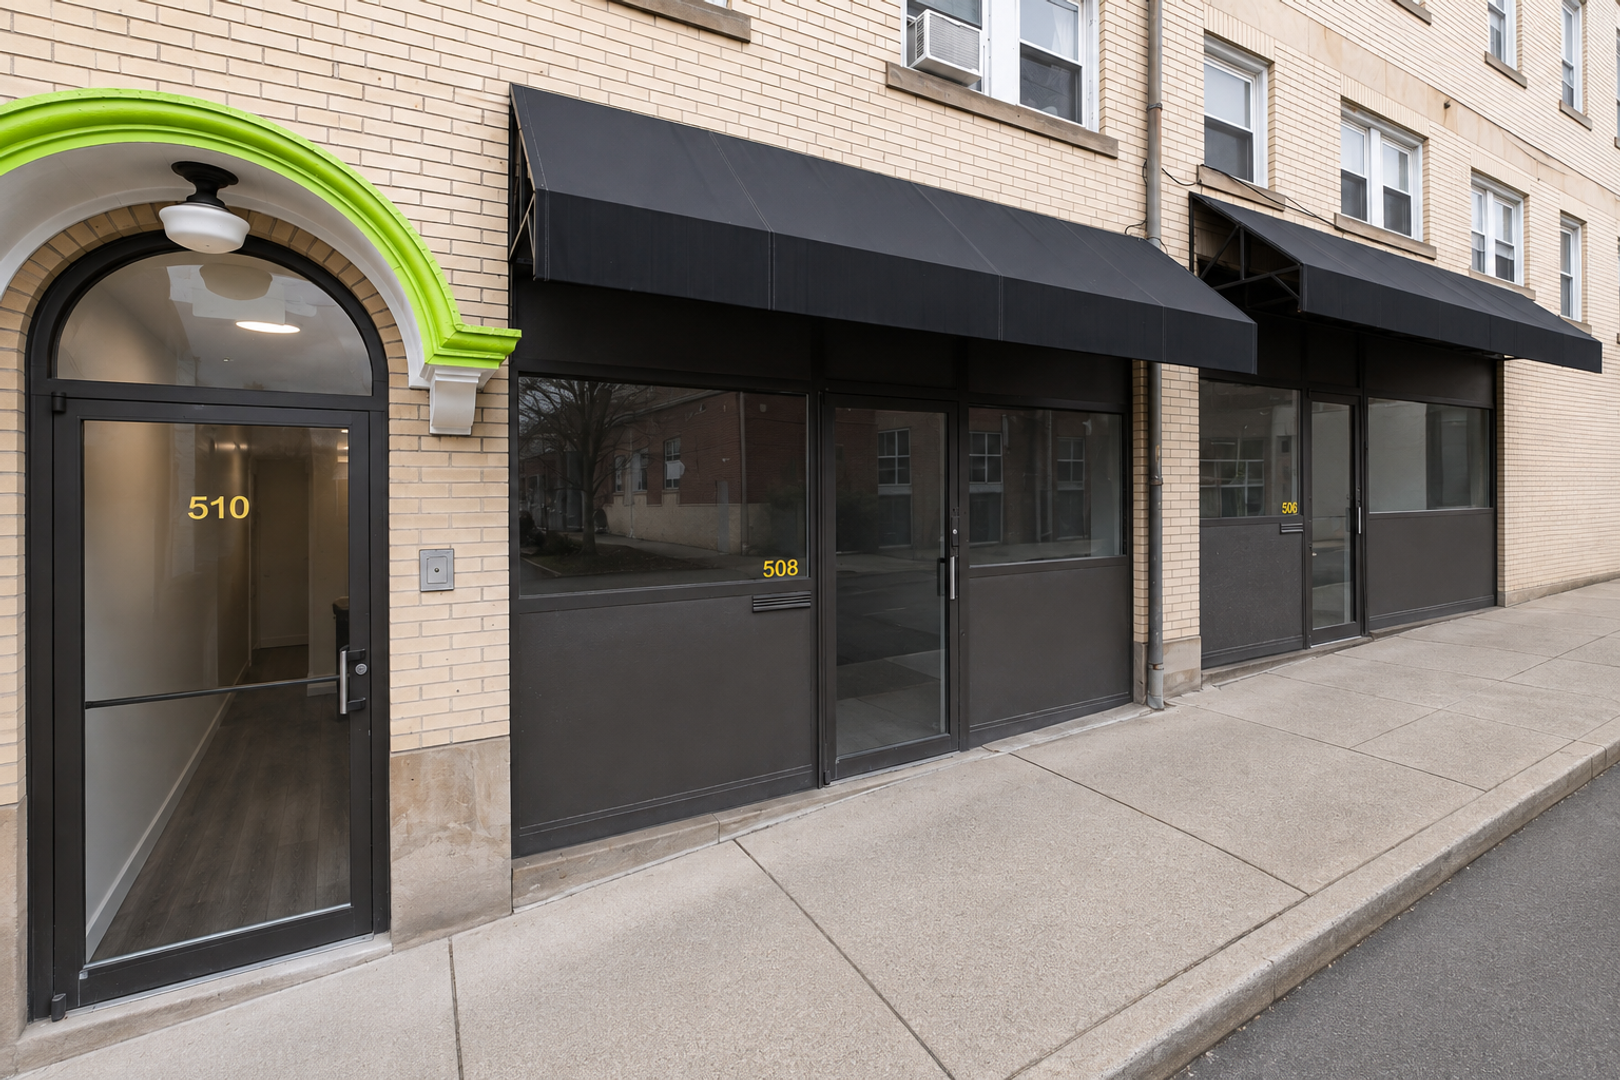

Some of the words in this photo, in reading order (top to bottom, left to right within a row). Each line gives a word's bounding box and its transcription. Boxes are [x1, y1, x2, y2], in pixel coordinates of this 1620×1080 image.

[188, 496, 250, 520] 510
[1282, 502, 1298, 514] 506
[763, 559, 799, 578] 508
